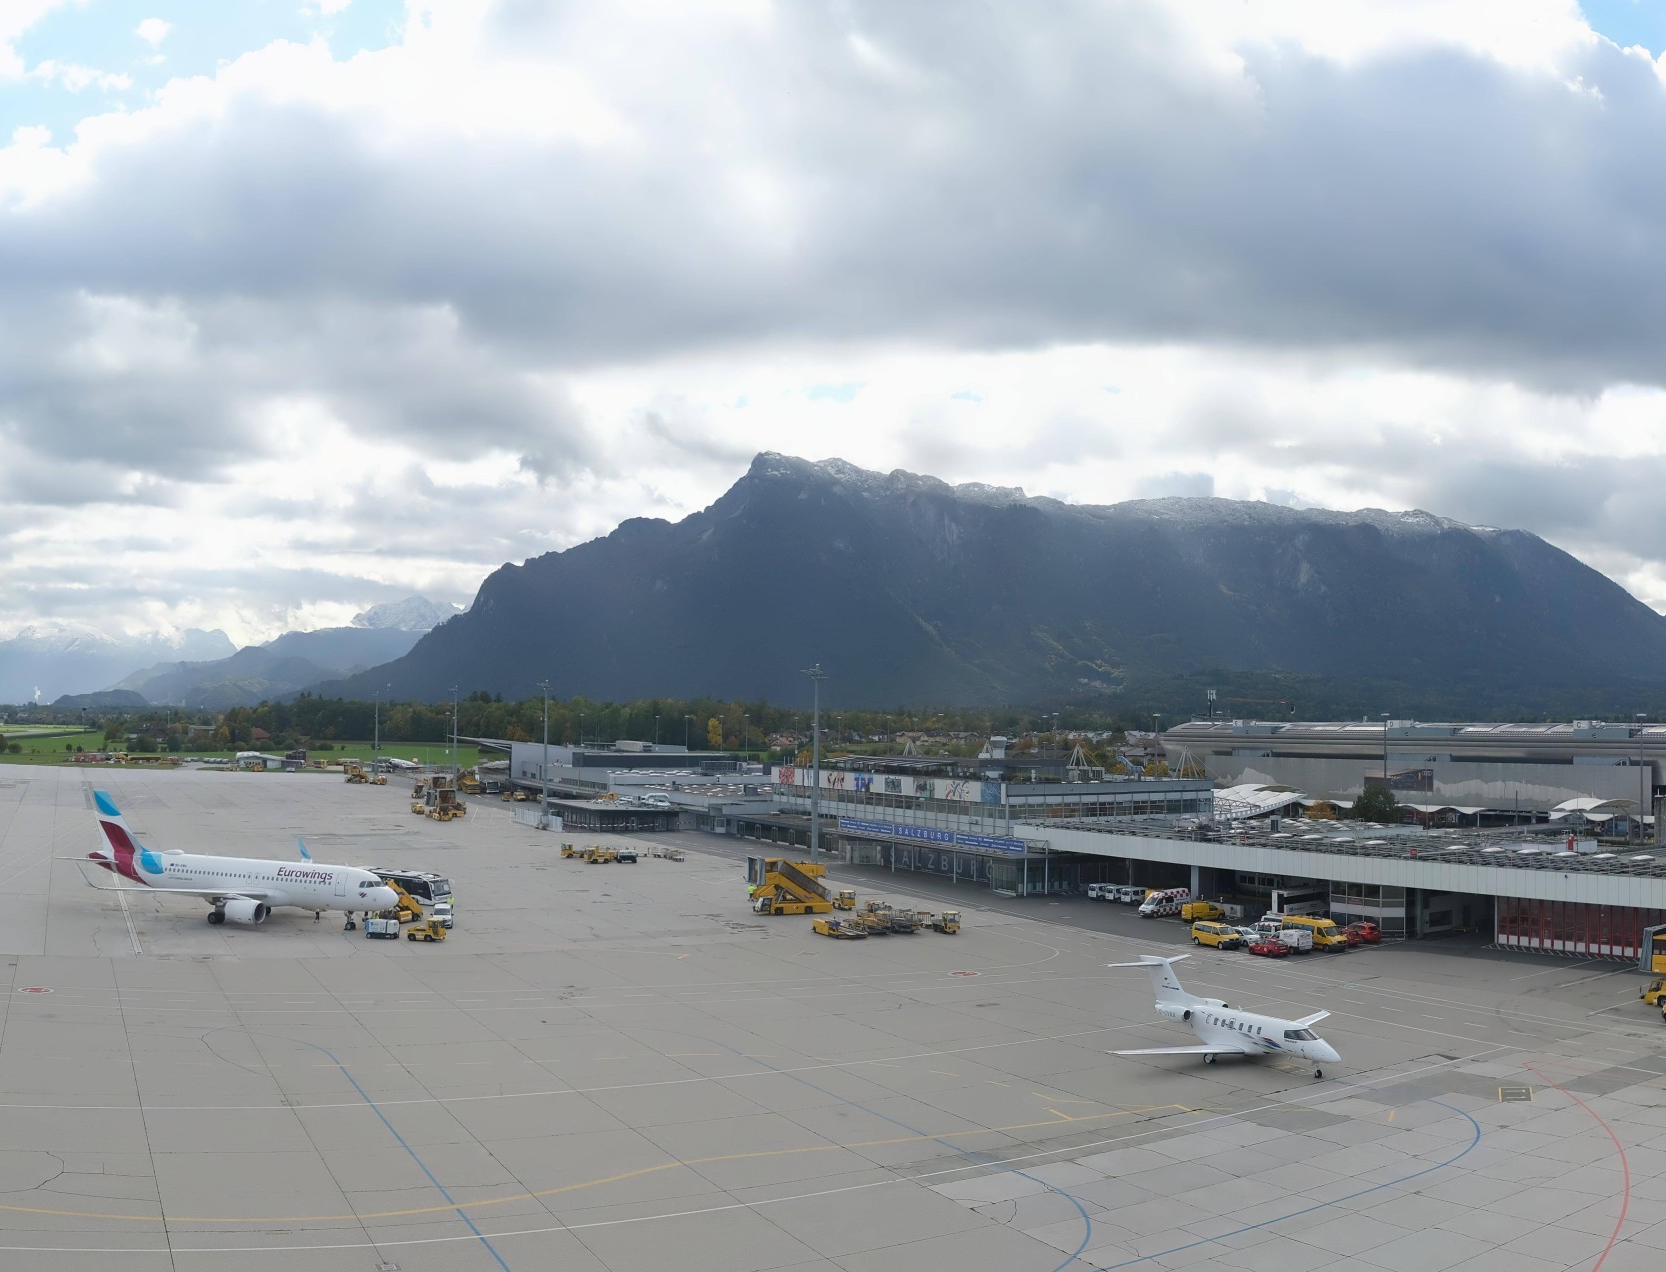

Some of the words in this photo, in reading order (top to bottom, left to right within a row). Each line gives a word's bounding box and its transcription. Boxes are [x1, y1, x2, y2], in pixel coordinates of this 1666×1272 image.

[898, 826, 950, 842] SALZBURG
[889, 844, 993, 878] SALZBURG
[276, 866, 334, 883] Eurowings
